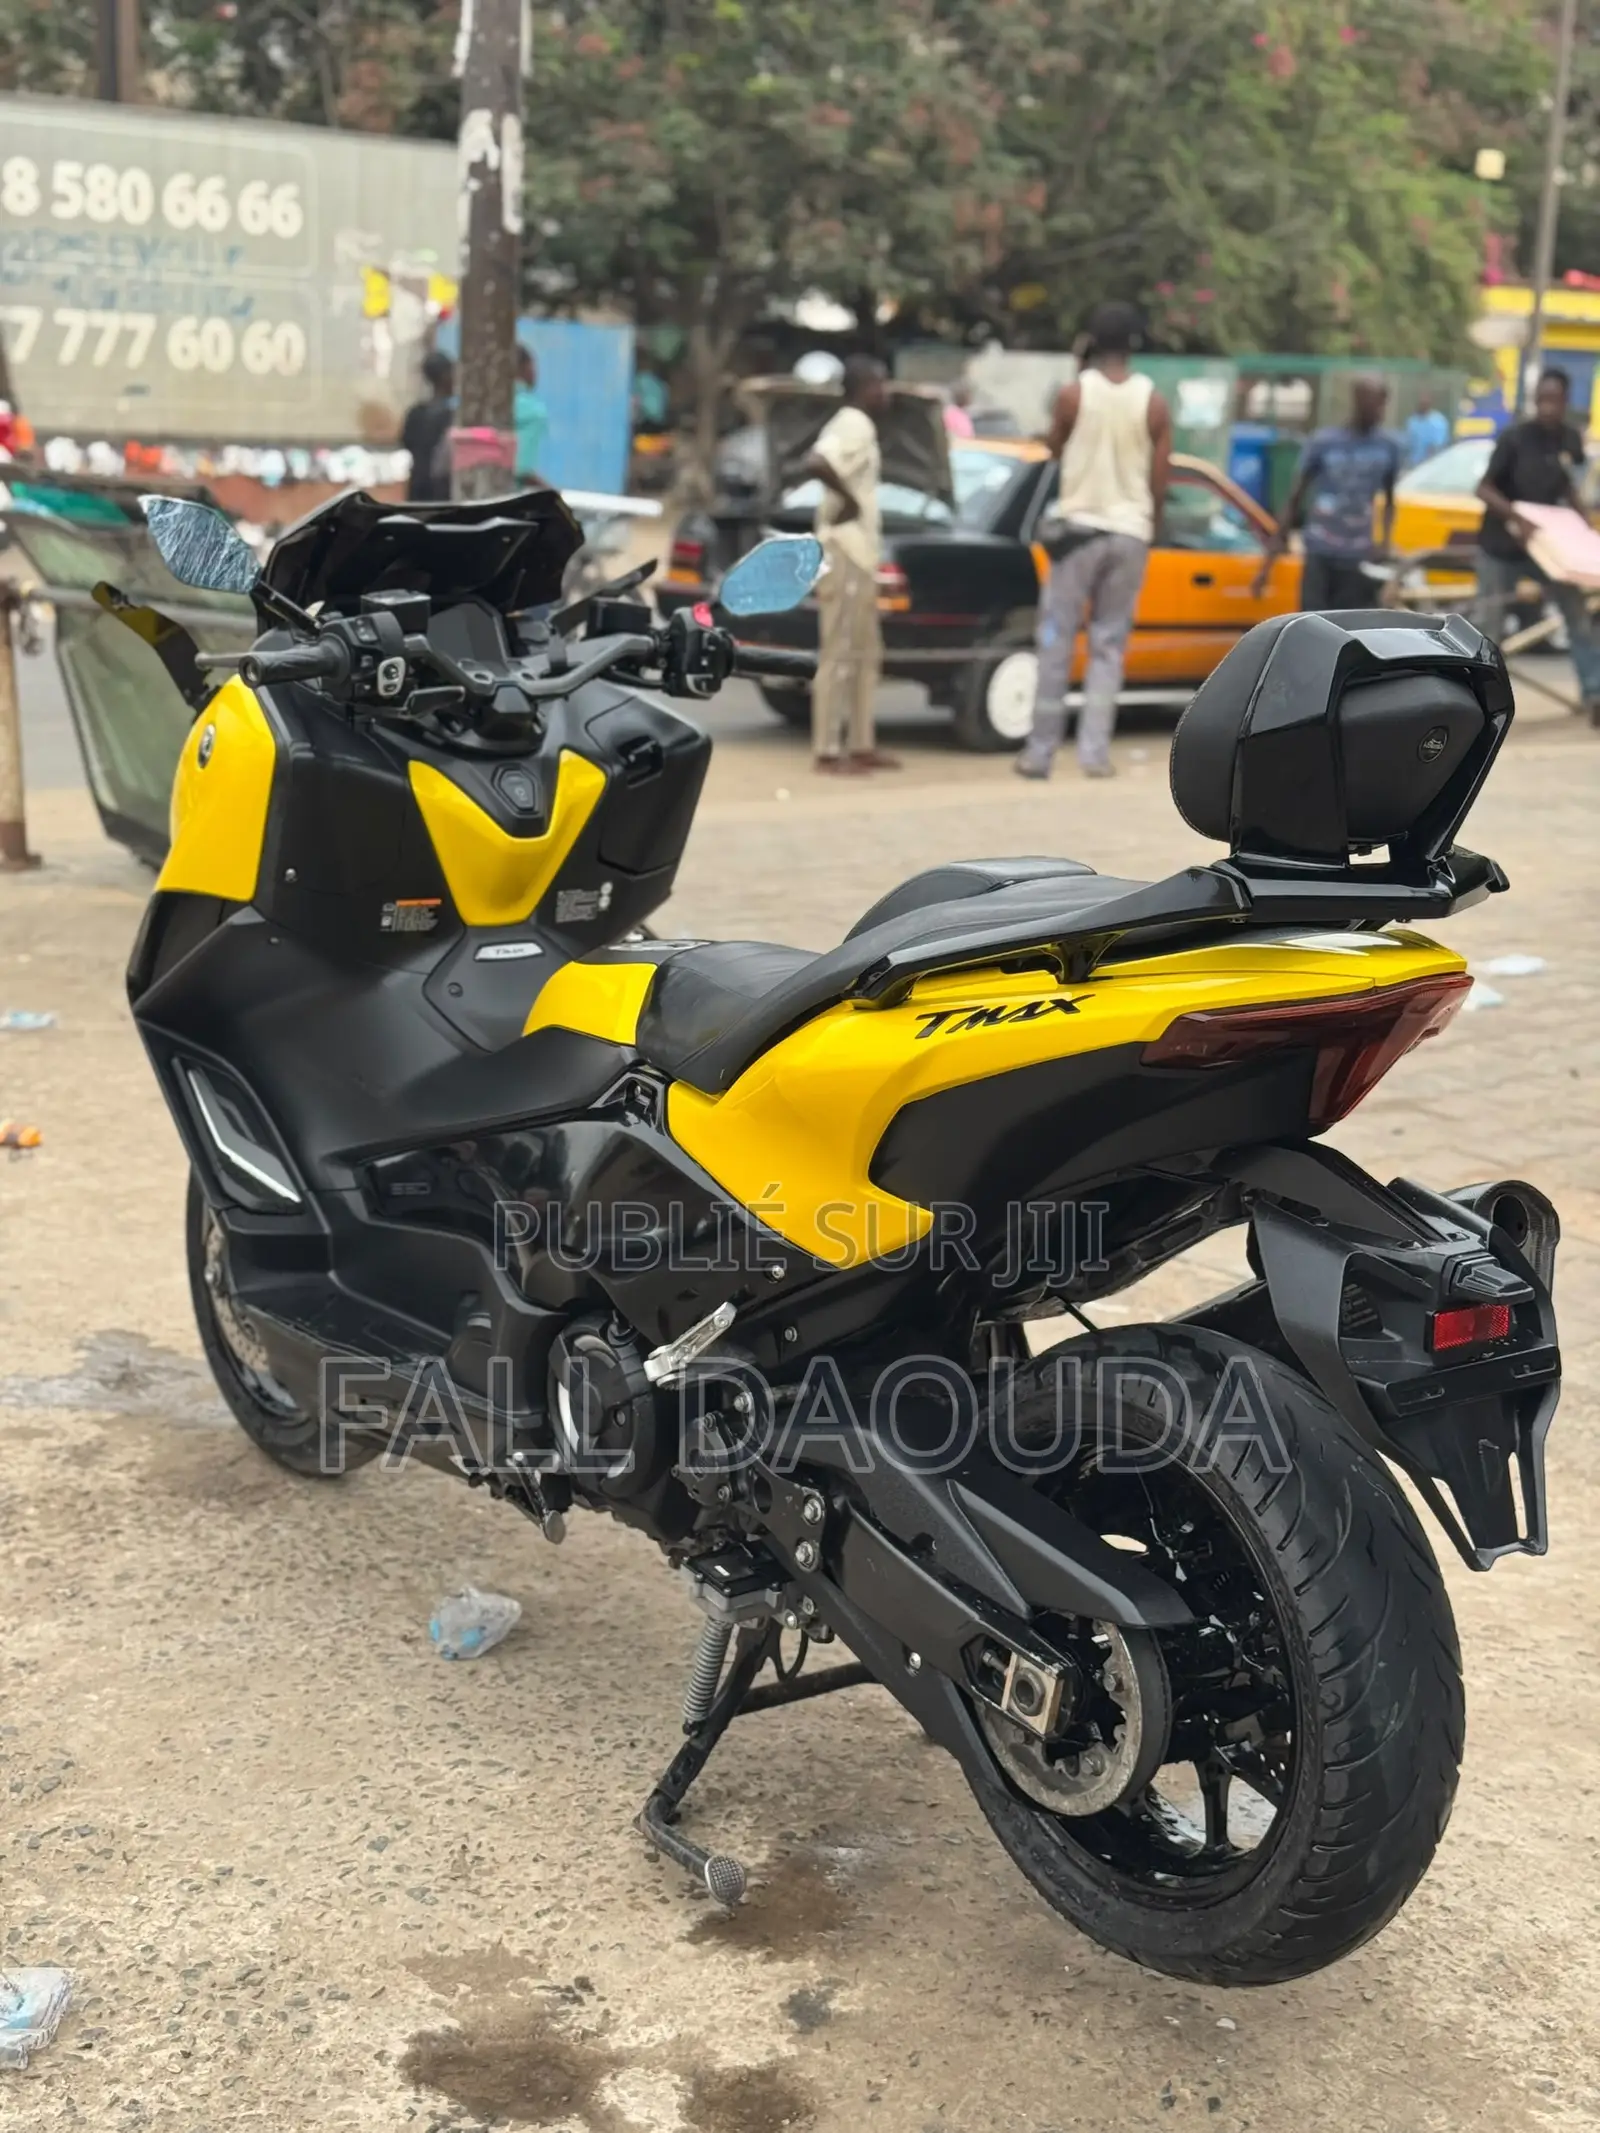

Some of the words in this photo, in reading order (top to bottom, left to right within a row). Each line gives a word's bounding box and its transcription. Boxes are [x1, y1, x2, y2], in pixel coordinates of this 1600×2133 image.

[1, 156, 41, 217] 8
[50, 160, 154, 225] 580
[161, 171, 232, 233] 66
[237, 179, 303, 239] 66
[0, 305, 43, 364] 7
[53, 307, 157, 370] 777
[166, 315, 235, 373] 60
[240, 319, 306, 377] 60
[915, 994, 1096, 1039] TMAX
